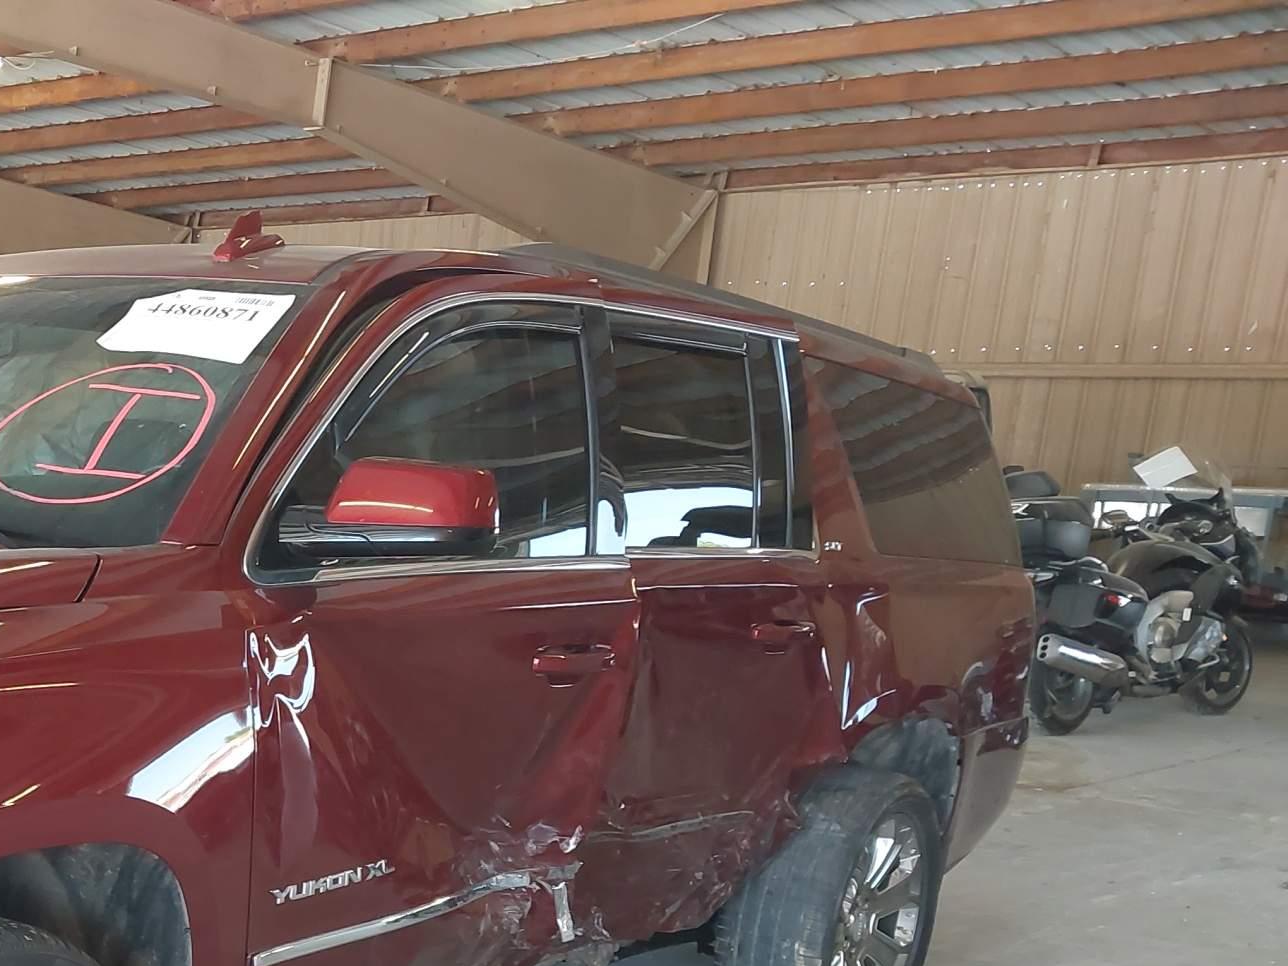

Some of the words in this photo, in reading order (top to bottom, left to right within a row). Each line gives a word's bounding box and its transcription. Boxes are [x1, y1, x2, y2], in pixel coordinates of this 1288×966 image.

[147, 302, 261, 322] 44860871
[268, 867, 363, 905] YUKON
[364, 859, 396, 881] XL
